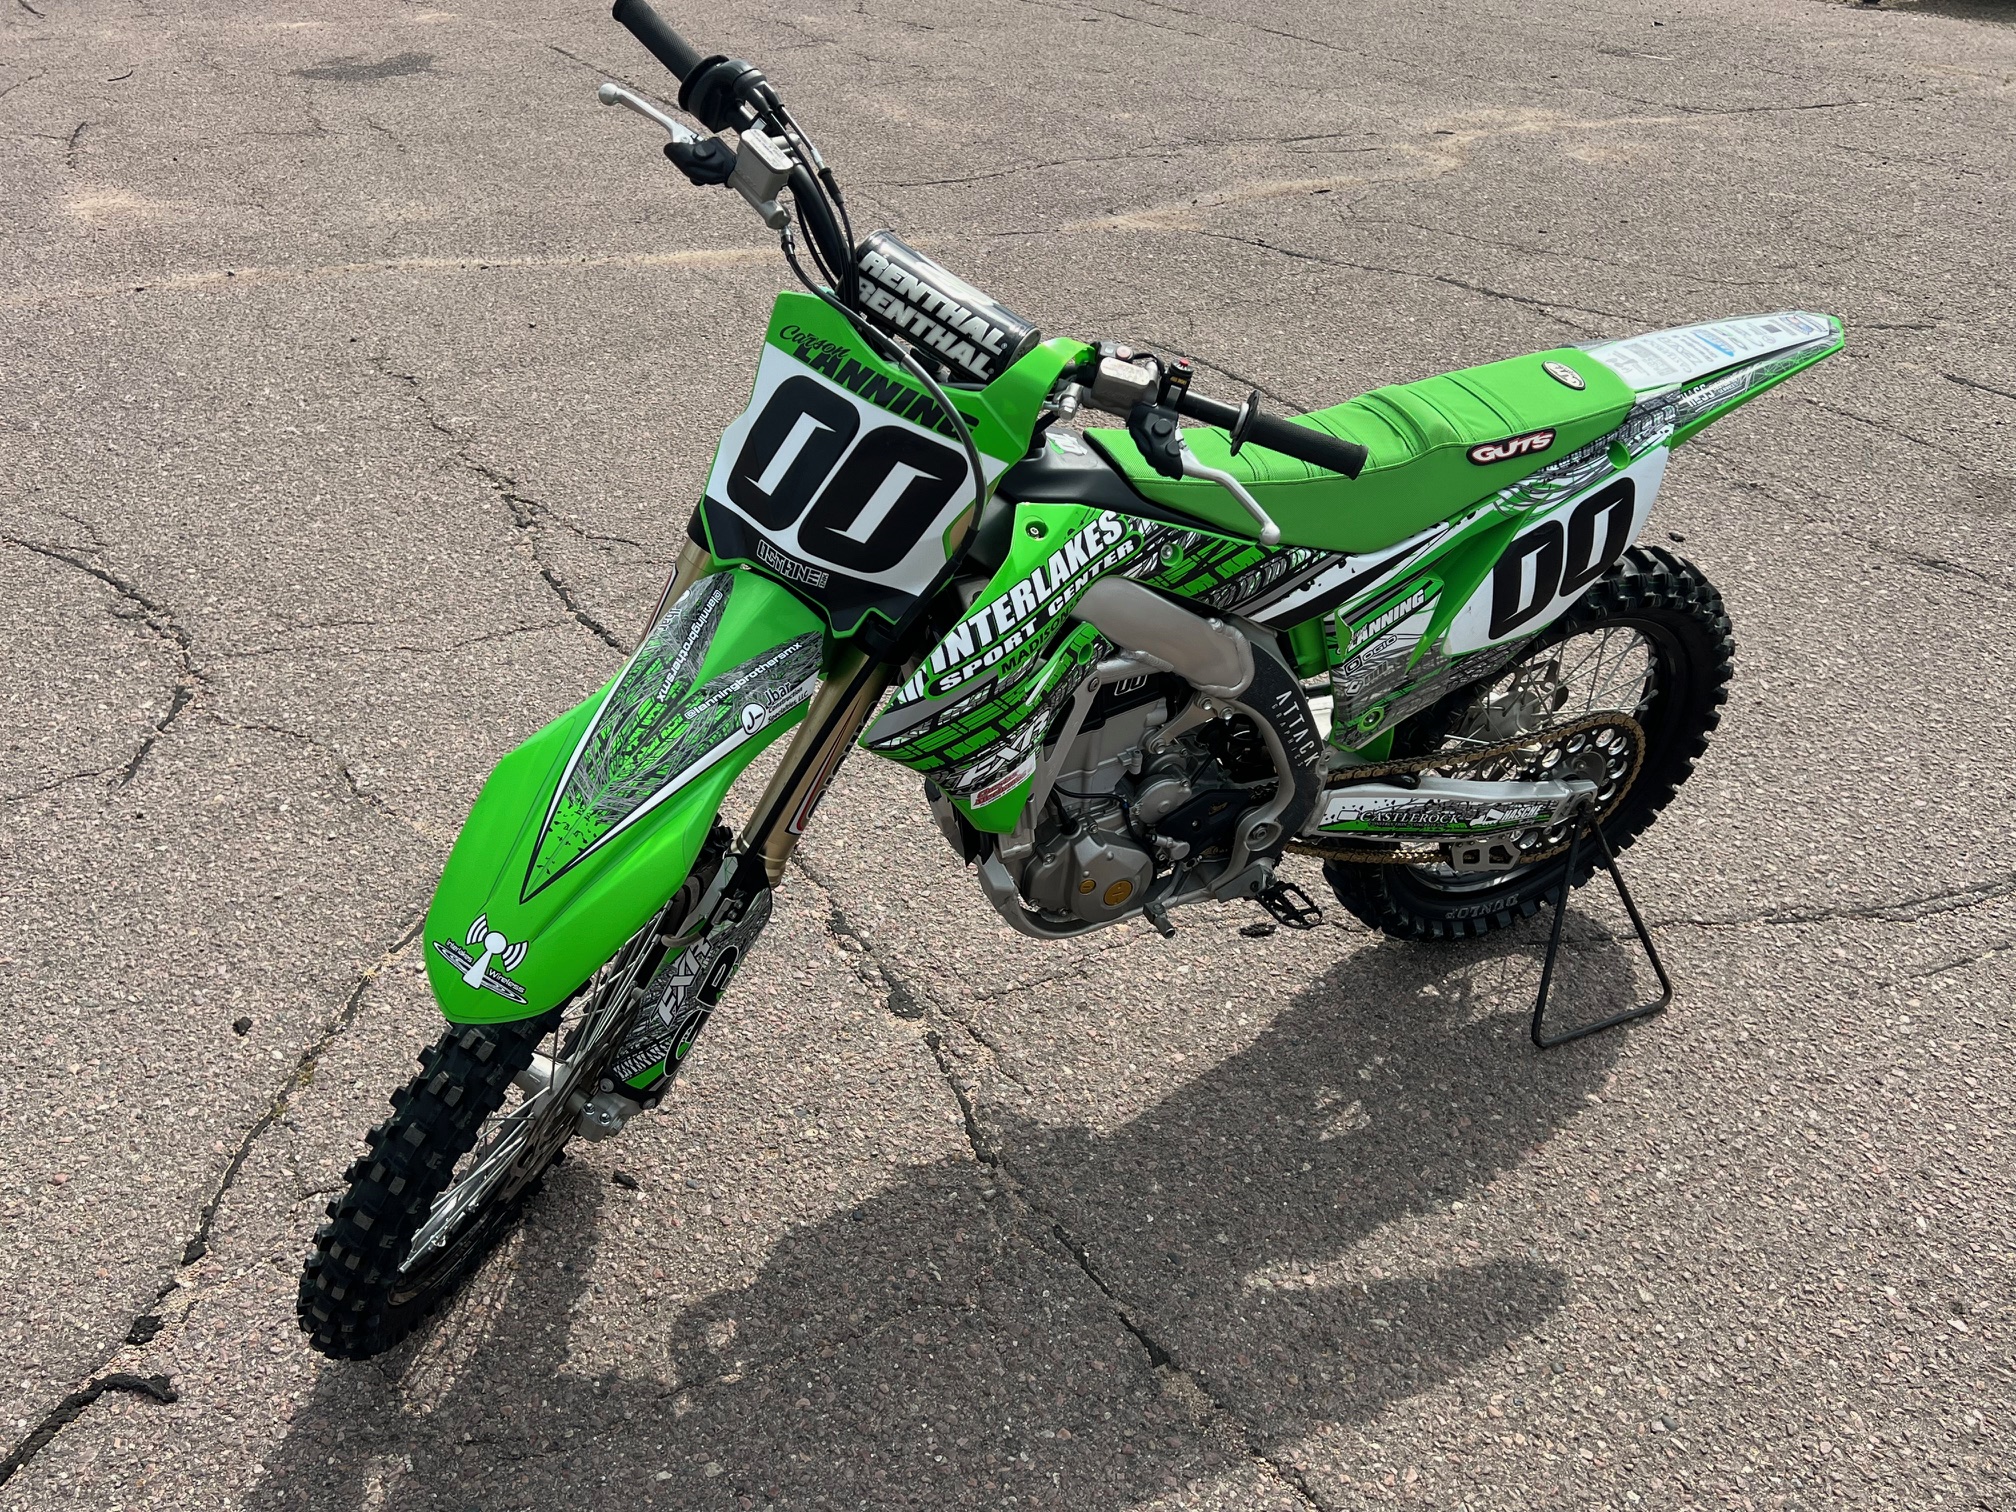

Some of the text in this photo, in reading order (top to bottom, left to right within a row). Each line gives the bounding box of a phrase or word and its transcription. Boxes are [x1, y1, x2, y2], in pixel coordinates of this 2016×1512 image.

[779, 324, 851, 359] Carson
[859, 250, 1005, 356] RENTHAL
[859, 275, 991, 381] RENTHAL
[793, 344, 980, 443] LANNING
[727, 375, 968, 574] 00
[1472, 432, 1554, 462] GUTS
[929, 510, 1127, 674] INTERLAKES
[1488, 477, 1636, 640] 00
[656, 589, 723, 703] @lanningbrothersmx
[940, 540, 1135, 692] SPORT CENTER
[1347, 588, 1425, 654] LANNING
[684, 641, 803, 721] @lanningbrothersmx
[764, 681, 792, 707] Jbar
[1275, 690, 1320, 767] ATTACK
[1360, 810, 1461, 824] CASTLEROCK
[652, 935, 714, 1028] FXR
